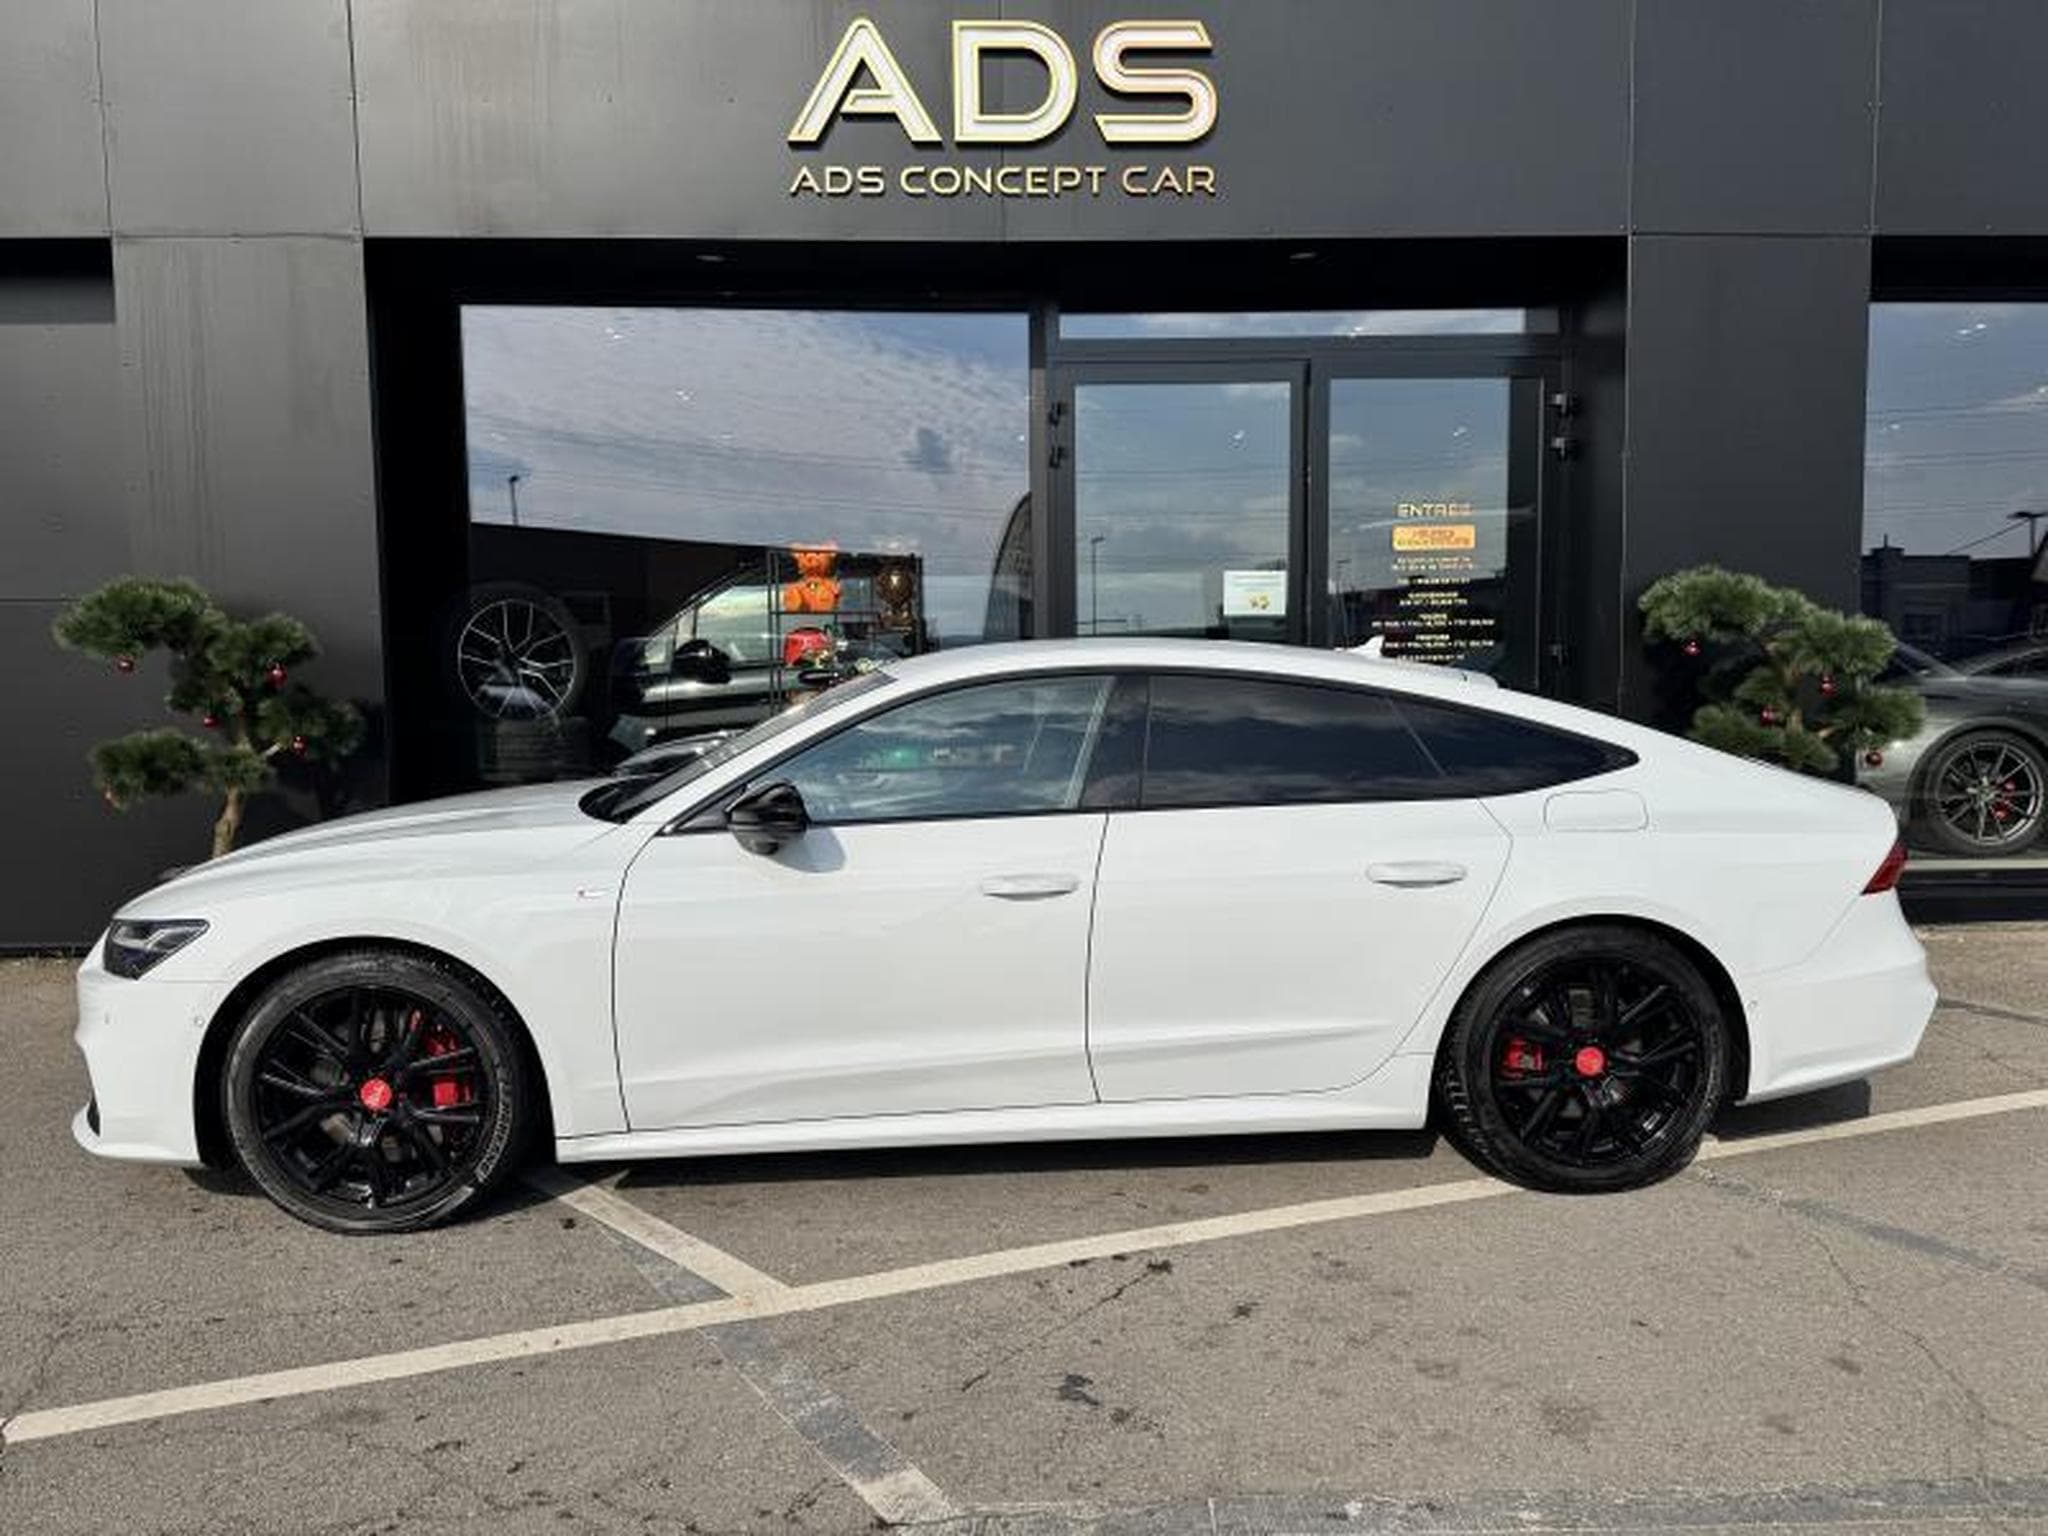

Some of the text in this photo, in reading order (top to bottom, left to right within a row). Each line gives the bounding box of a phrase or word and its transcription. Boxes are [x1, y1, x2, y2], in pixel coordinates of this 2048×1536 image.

[788, 17, 1218, 143] ADS
[790, 165, 1217, 195] ADS CONCEPT CAR
